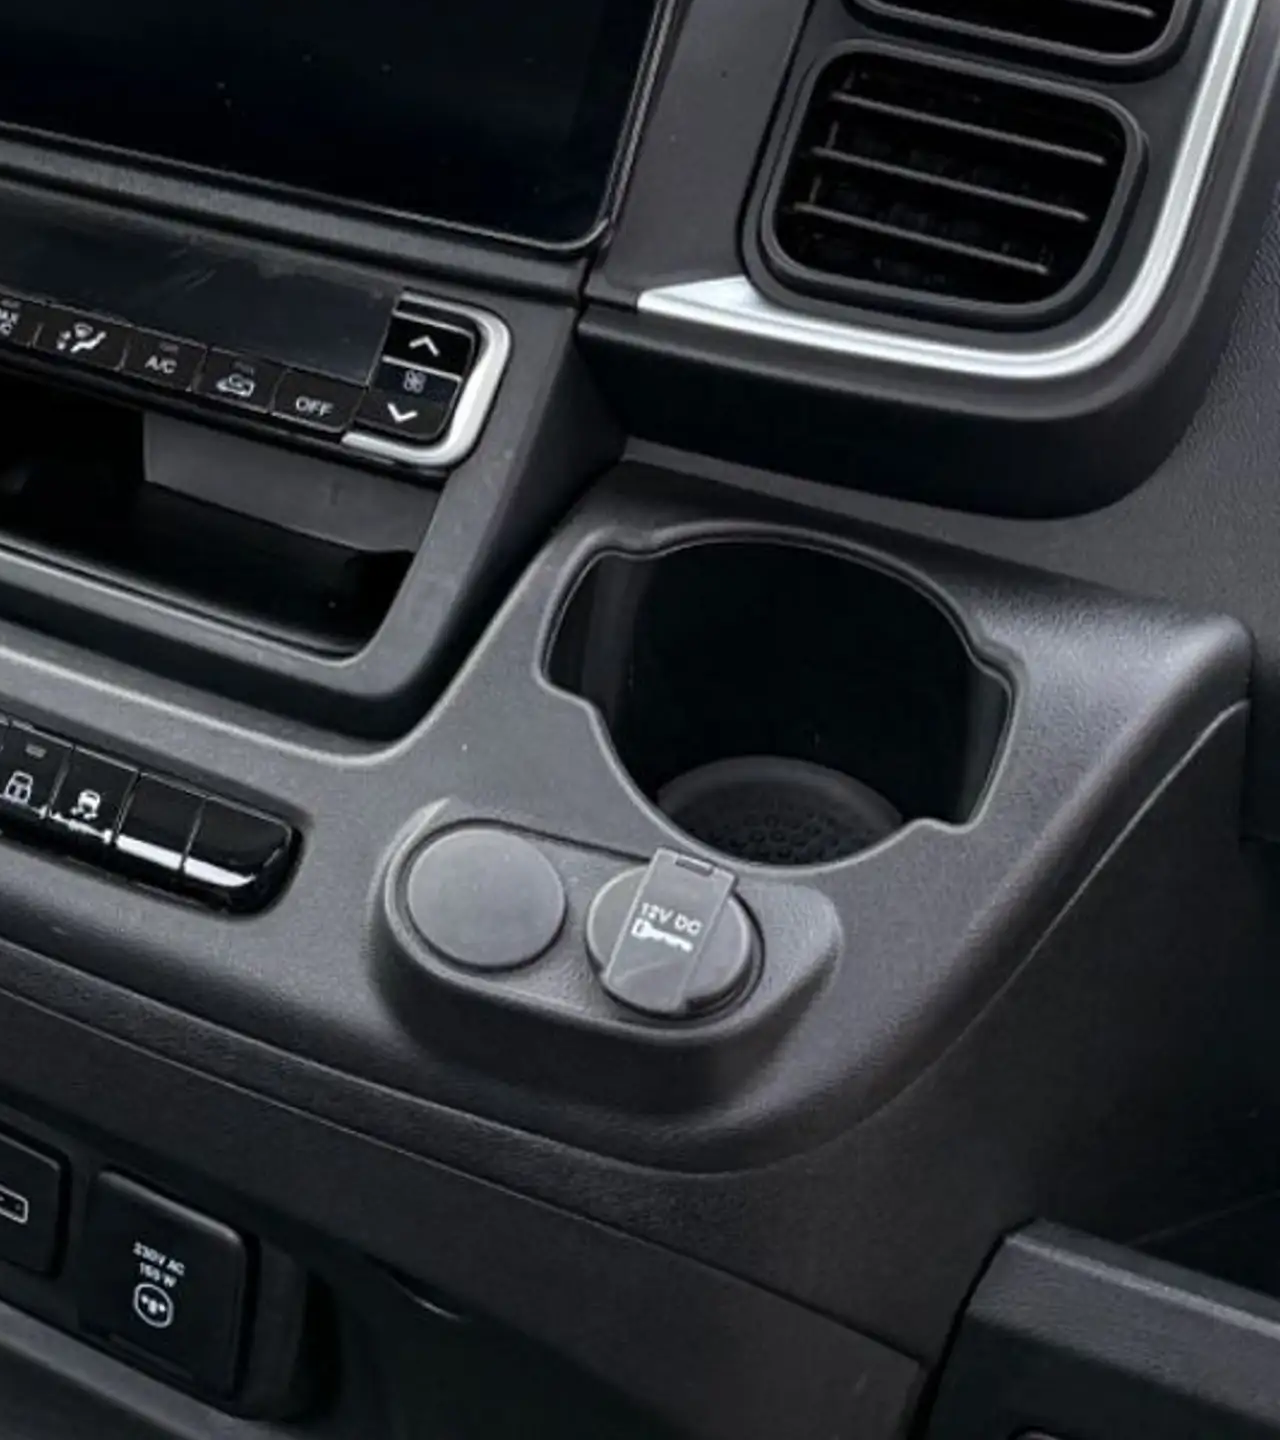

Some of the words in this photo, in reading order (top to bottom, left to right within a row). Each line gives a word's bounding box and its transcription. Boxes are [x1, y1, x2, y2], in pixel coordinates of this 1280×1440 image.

[144, 355, 178, 374] A/C
[295, 395, 334, 417] OFF
[642, 902, 675, 925] 12V
[674, 912, 703, 938] DC
